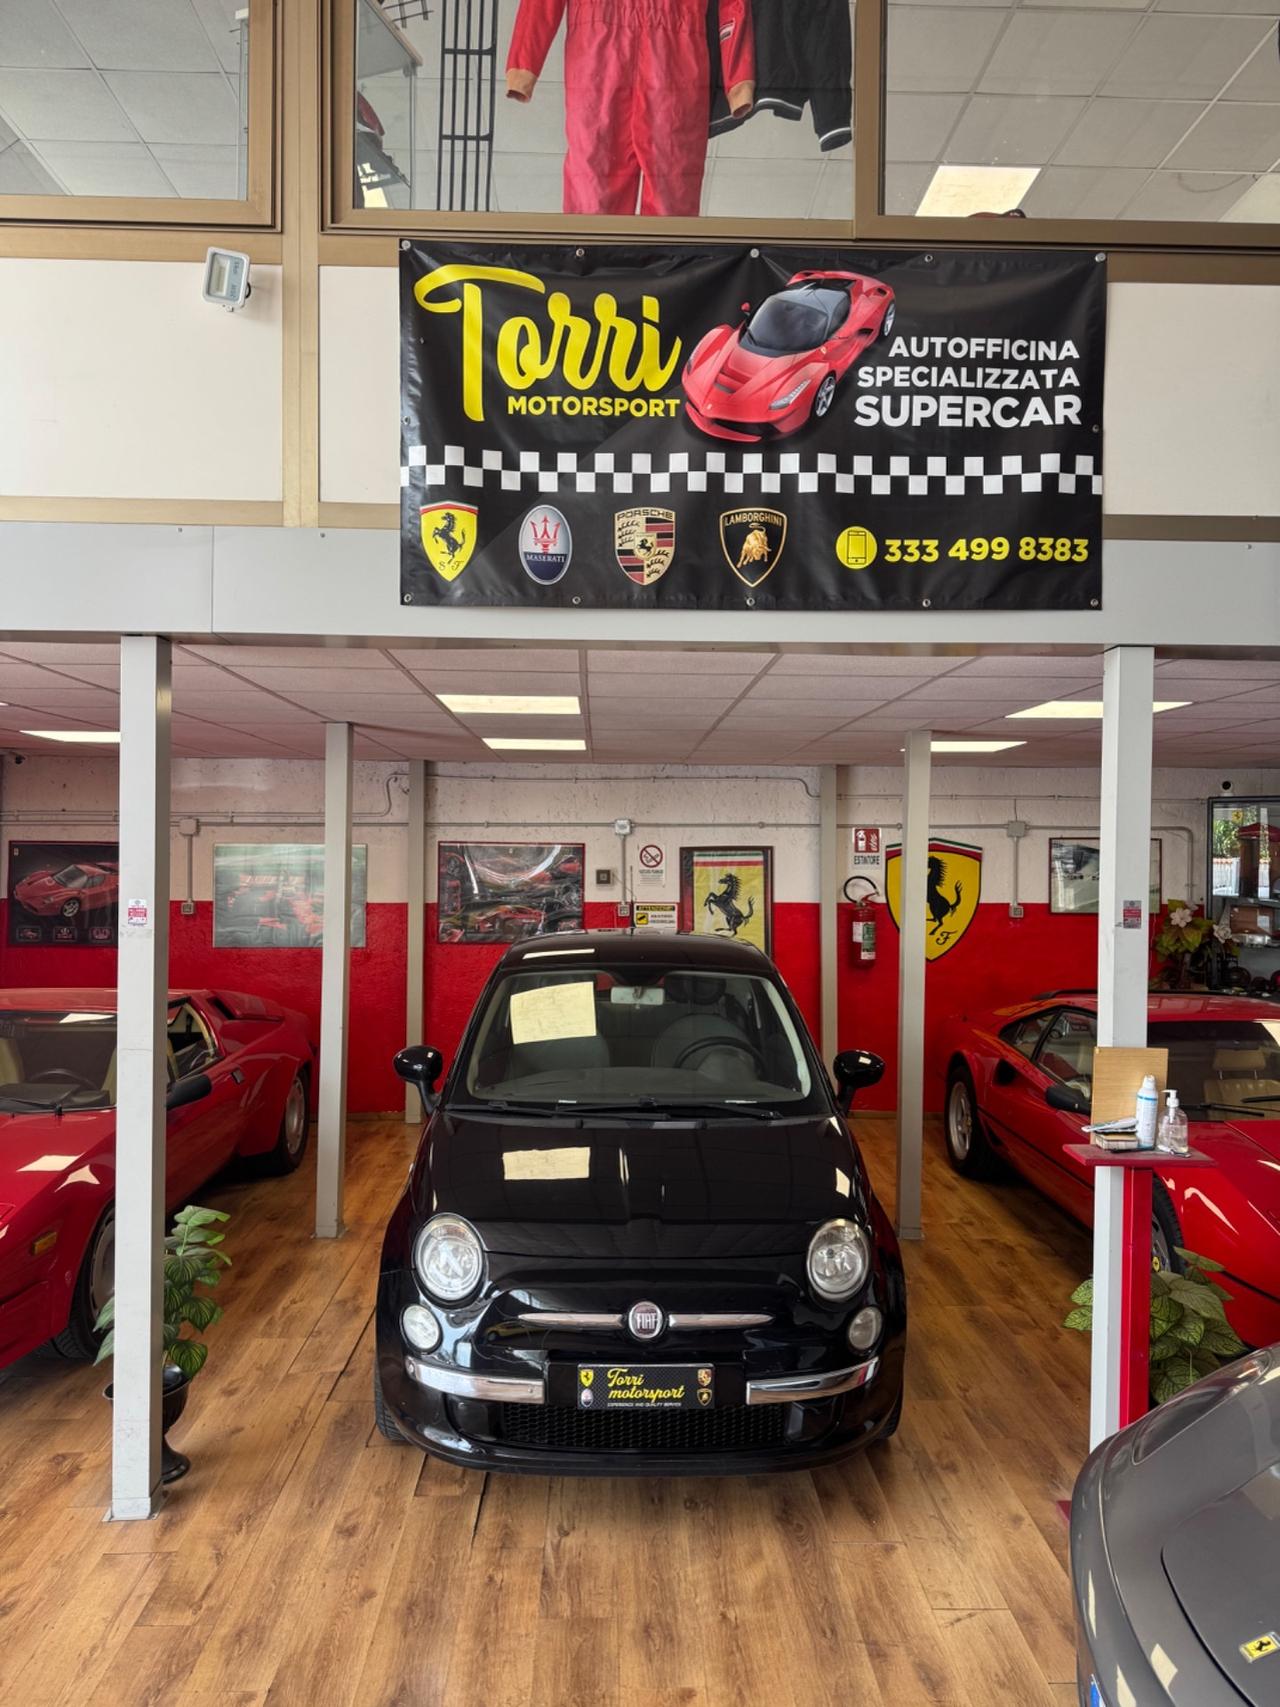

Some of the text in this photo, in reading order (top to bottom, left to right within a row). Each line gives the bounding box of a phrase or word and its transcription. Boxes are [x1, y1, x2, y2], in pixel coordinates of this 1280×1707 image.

[414, 264, 682, 421] Torri
[888, 336, 1080, 361] AUTOFFICINA
[857, 366, 1080, 390] SPECIALIZZATA
[508, 396, 681, 417] MOTORSPORT
[854, 395, 1082, 428] SUPERCAR
[617, 509, 673, 521] PORSCHE
[725, 512, 782, 527] LAMBORGHINI
[526, 553, 565, 563] MASERATI
[884, 537, 1089, 563] 333 499 8383
[636, 1312, 658, 1329] FIAT
[607, 1368, 644, 1387] Torri
[608, 1385, 685, 1403] motorsport
